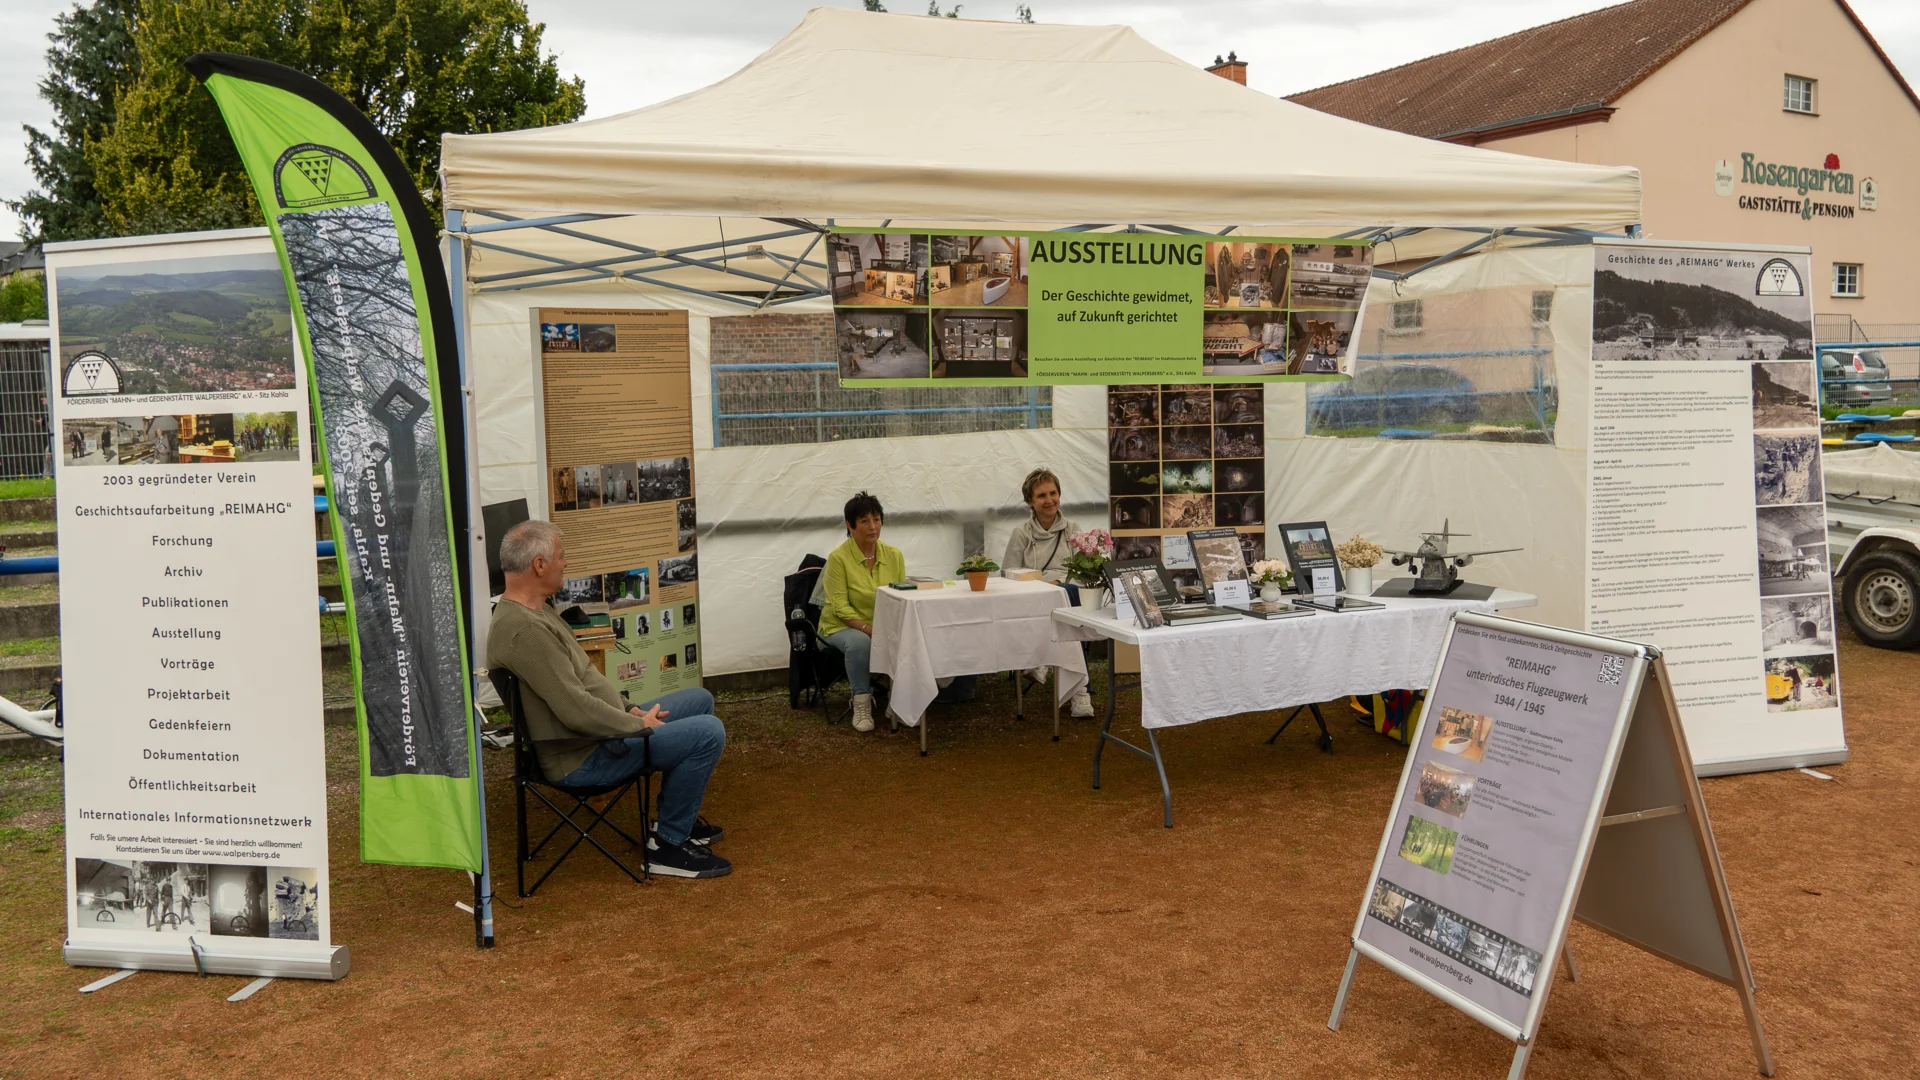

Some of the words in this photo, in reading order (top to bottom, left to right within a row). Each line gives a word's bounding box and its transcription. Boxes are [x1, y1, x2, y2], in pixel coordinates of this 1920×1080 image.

[1740, 152, 1854, 196] Rosengarten
[1739, 196, 1801, 214] GASTSTÄTTE
[1801, 198, 1812, 220] &
[1812, 202, 1854, 218] PENSION
[1030, 240, 1202, 266] AUSSTELLUNG
[1608, 254, 1655, 265] Geschichte
[1658, 256, 1672, 266] des
[1675, 256, 1723, 269] „REIMAHG“
[1726, 259, 1755, 269] Werkes
[1042, 290, 1063, 301] Der
[1066, 290, 1130, 302] Geschichte
[1132, 291, 1192, 304] gewidmet,
[1057, 311, 1076, 322] auf
[1079, 310, 1124, 322] Zukunft
[1127, 311, 1177, 324] gerichtet
[68, 397, 109, 405] FÖRDERVEREIN
[149, 393, 193, 402] GEDENKSTÄTTE
[103, 475, 134, 487] 2003
[139, 473, 212, 486] gegründeter
[217, 472, 256, 484] Verein
[75, 504, 215, 517] Geschichtsaufarbeitung
[220, 503, 292, 516] „REIMAHG“
[152, 535, 213, 548] Forschung
[164, 566, 203, 577] Archiv
[142, 597, 229, 608] Publikationen
[152, 628, 221, 640] Ausstellung
[1457, 626, 1480, 637] Entdecken
[1498, 634, 1506, 642] fast
[1507, 637, 1539, 649] unbekanntes
[1539, 642, 1553, 651] Stück
[1554, 645, 1592, 658] Zeitgeschichte
[161, 659, 215, 671] Vorträge
[1466, 669, 1524, 690] unterirdisches
[1526, 681, 1588, 706] Flugzeugwerk
[147, 688, 231, 702] Projektarbeit
[1494, 694, 1515, 708] 1944
[1516, 699, 1523, 711] /
[1523, 701, 1545, 715] 1945
[149, 718, 231, 731] Gedenkfeiern
[1495, 720, 1526, 733] AUSSTELLUNG
[143, 749, 240, 762] Dokumentation
[128, 776, 256, 794] Öffentlichkeitsarbeit
[1478, 777, 1502, 790] VORTRÄGE
[79, 808, 170, 823] Internationales
[174, 811, 312, 828] Informationsnetzwerk
[91, 833, 105, 842] Falls
[106, 834, 116, 842] Sie
[140, 836, 161, 844] Arbeit
[162, 836, 197, 845] interessiert
[204, 838, 214, 846] Sie
[215, 839, 229, 847] sind
[231, 839, 256, 848] herzlich
[258, 840, 303, 849] willkommen!
[1461, 834, 1489, 850] FÜHRUNGEN
[116, 845, 160, 854] Kontaktieren
[161, 847, 171, 855] Sie
[186, 848, 200, 856] über
[202, 849, 280, 860] www.walpersberg.de
[1409, 946, 1473, 984] www.walpersberg.de
